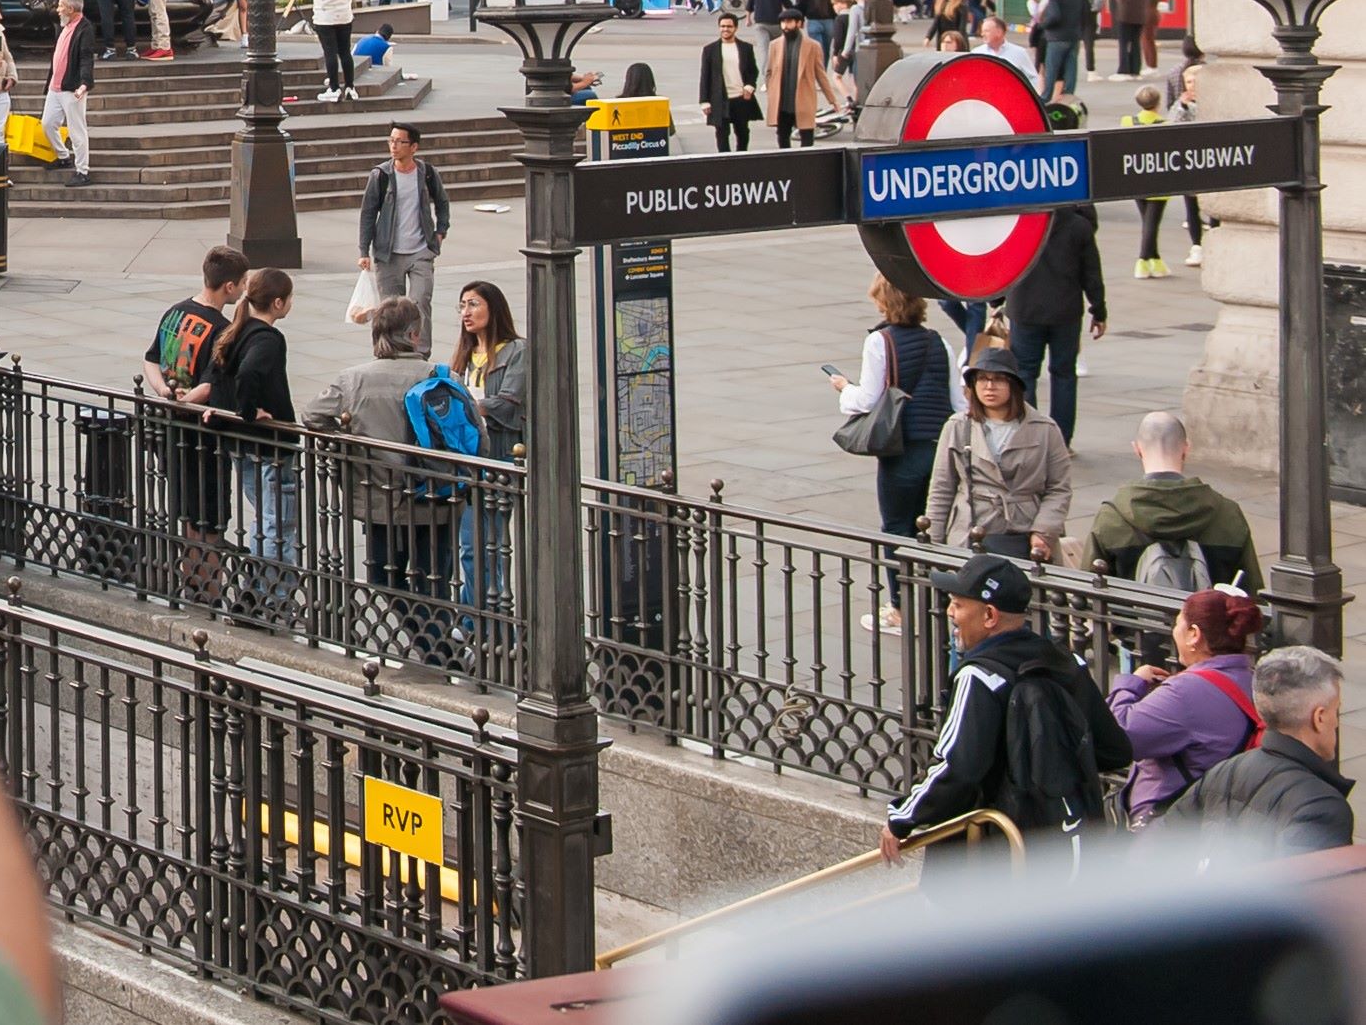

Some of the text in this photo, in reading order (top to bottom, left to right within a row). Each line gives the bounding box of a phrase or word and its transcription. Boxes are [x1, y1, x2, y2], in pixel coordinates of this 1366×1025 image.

[612, 133, 630, 142] WEST
[612, 140, 660, 151] Piccadilly Circus
[1123, 144, 1255, 175] PUBLIC SUBWAY
[867, 155, 1079, 203] UNDERGROUND
[626, 179, 792, 214] PUBLIC SUBWAY
[383, 802, 423, 836] RVP
